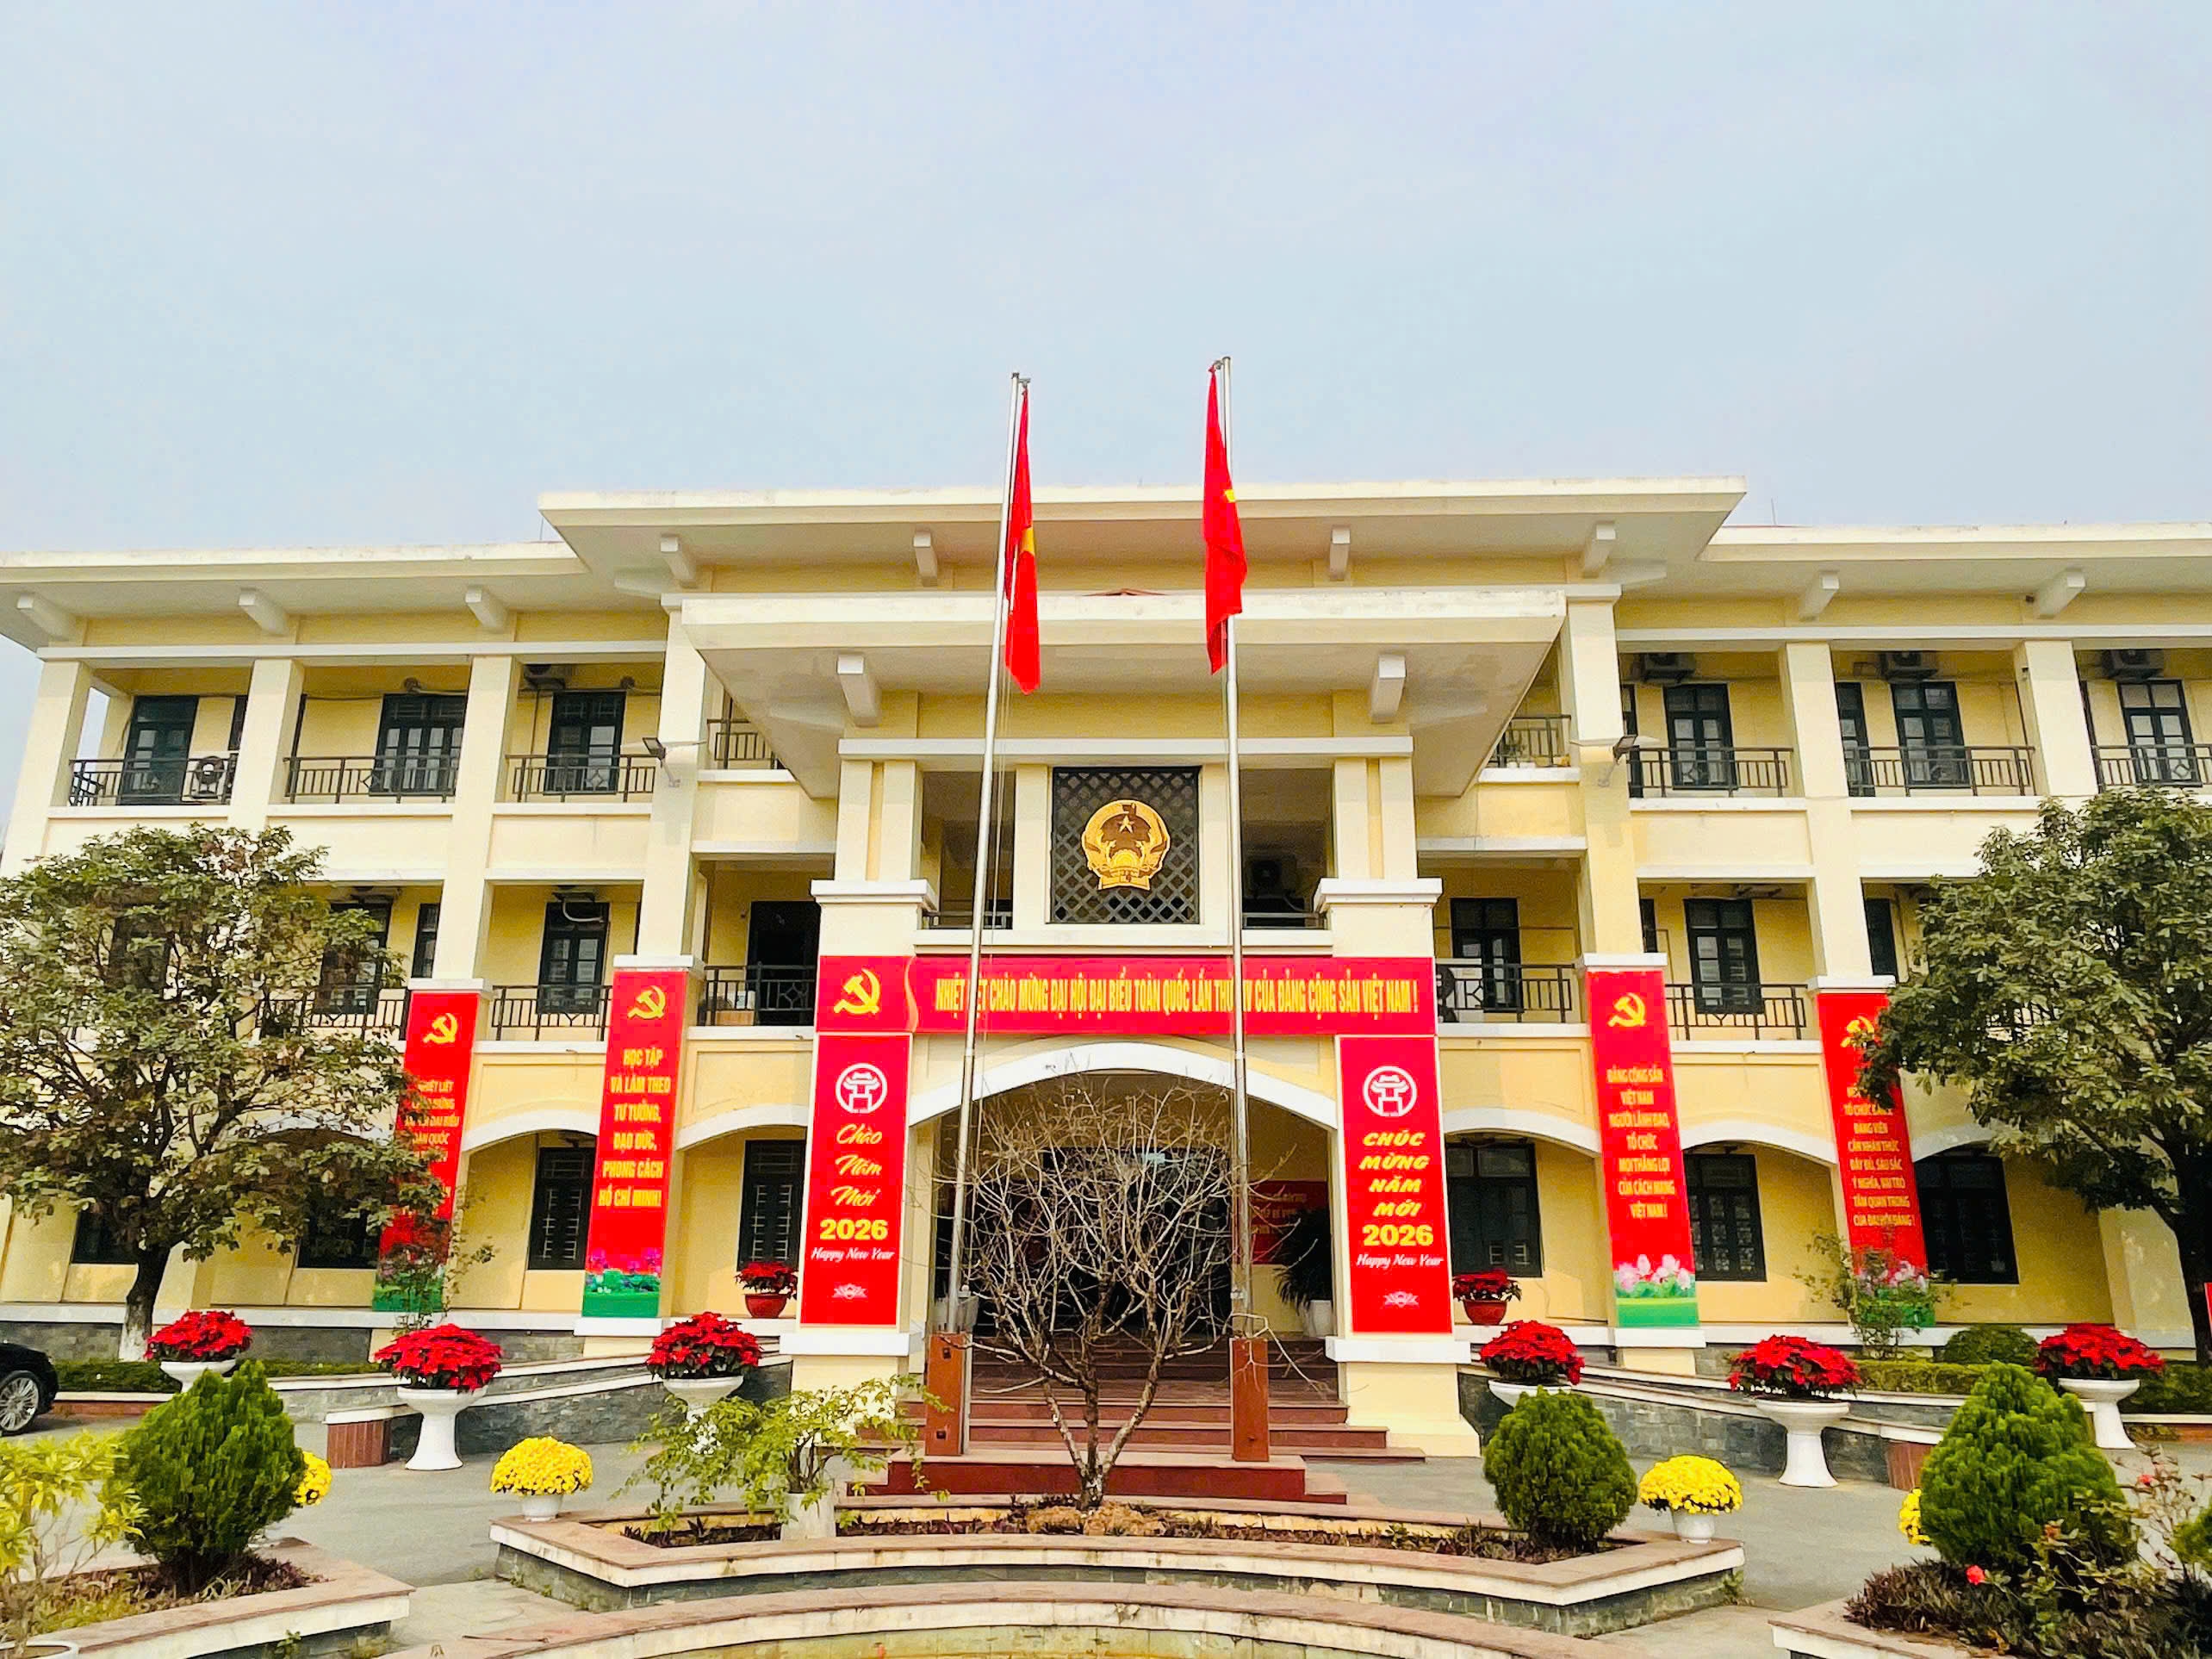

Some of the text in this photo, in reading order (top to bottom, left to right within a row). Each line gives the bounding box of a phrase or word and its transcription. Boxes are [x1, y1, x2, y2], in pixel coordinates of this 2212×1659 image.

[935, 972, 966, 1019] NHIỆT
[990, 972, 1016, 1012] CHÀO
[1018, 972, 1048, 1012] MỪNG
[1050, 979, 1068, 1019] ĐẠI
[1070, 972, 1087, 1019] HỘI
[1089, 979, 1106, 1020] ĐẠI
[1109, 966, 1132, 1012] BIỂU
[1134, 972, 1160, 1012] TOÀN
[1163, 967, 1190, 1016] QUỐC
[1255, 968, 1276, 1012] CỦA
[1277, 968, 1306, 1012] ĐẢNG
[1308, 972, 1336, 1020] CỘNG
[1339, 968, 1360, 1012] SẢN
[1362, 972, 1383, 1020] VIỆT
[623, 1047, 643, 1069] HỌC
[624, 1073, 645, 1093] LÀM
[648, 1076, 671, 1094] THEO
[836, 1123, 883, 1144] Chào
[1363, 1130, 1426, 1146] CHÚC
[603, 1158, 663, 1178] PHONG CÁCH
[835, 1154, 883, 1176] Năm
[1358, 1152, 1430, 1170] MỪNG
[1368, 1175, 1422, 1192] NĂM
[830, 1185, 881, 1206] Mới
[1372, 1199, 1421, 1217] MỚI
[820, 1218, 888, 1240] 2026
[1363, 1224, 1433, 1246] 2026
[811, 1247, 895, 1263] Happy New Year
[1356, 1253, 1444, 1270] Happy New Year
